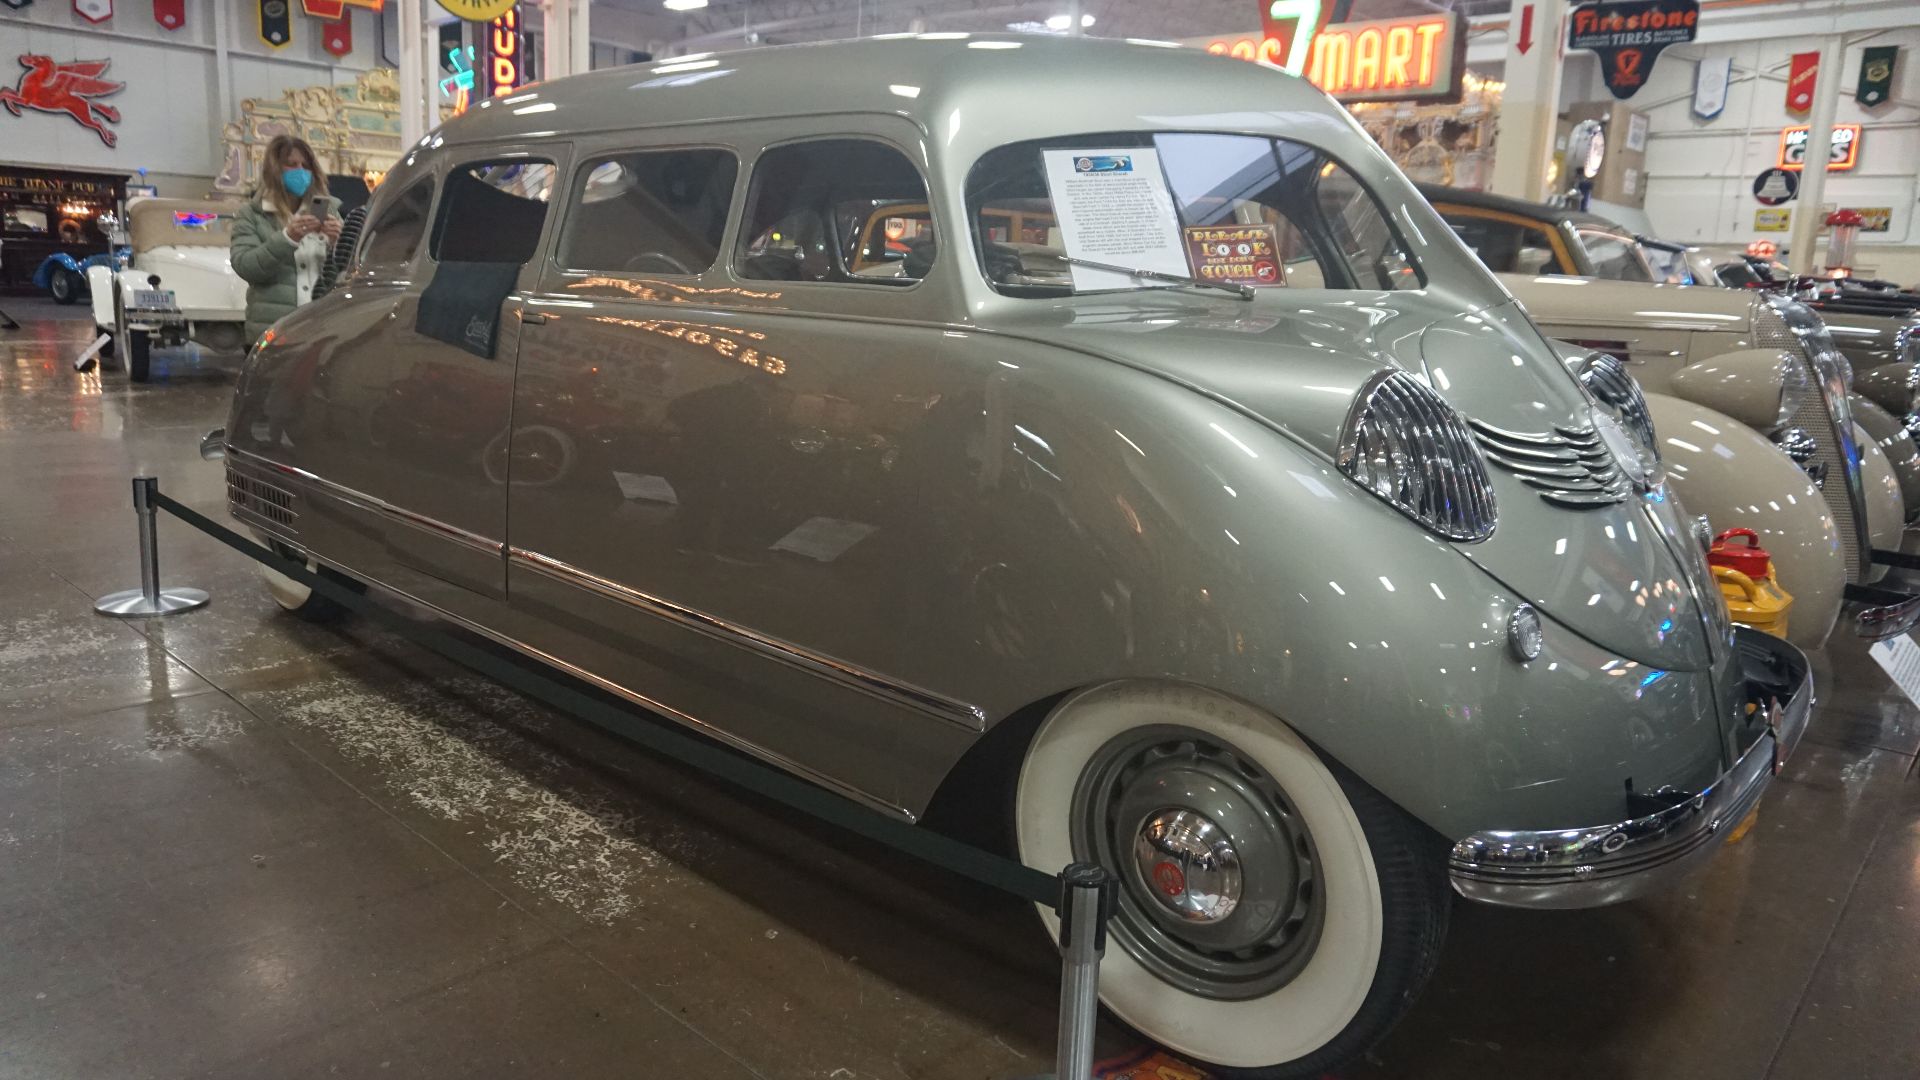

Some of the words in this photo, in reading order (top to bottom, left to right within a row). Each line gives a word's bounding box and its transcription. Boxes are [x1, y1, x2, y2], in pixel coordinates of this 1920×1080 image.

[1574, 9, 1697, 36] Firestone
[1612, 32, 1652, 46] TIRES
[1310, 21, 1445, 92] MART
[1785, 143, 1850, 163] GS
[1192, 229, 1268, 241] PLEASE
[1201, 241, 1271, 256] LOOK
[1201, 264, 1256, 278] TOUCH
